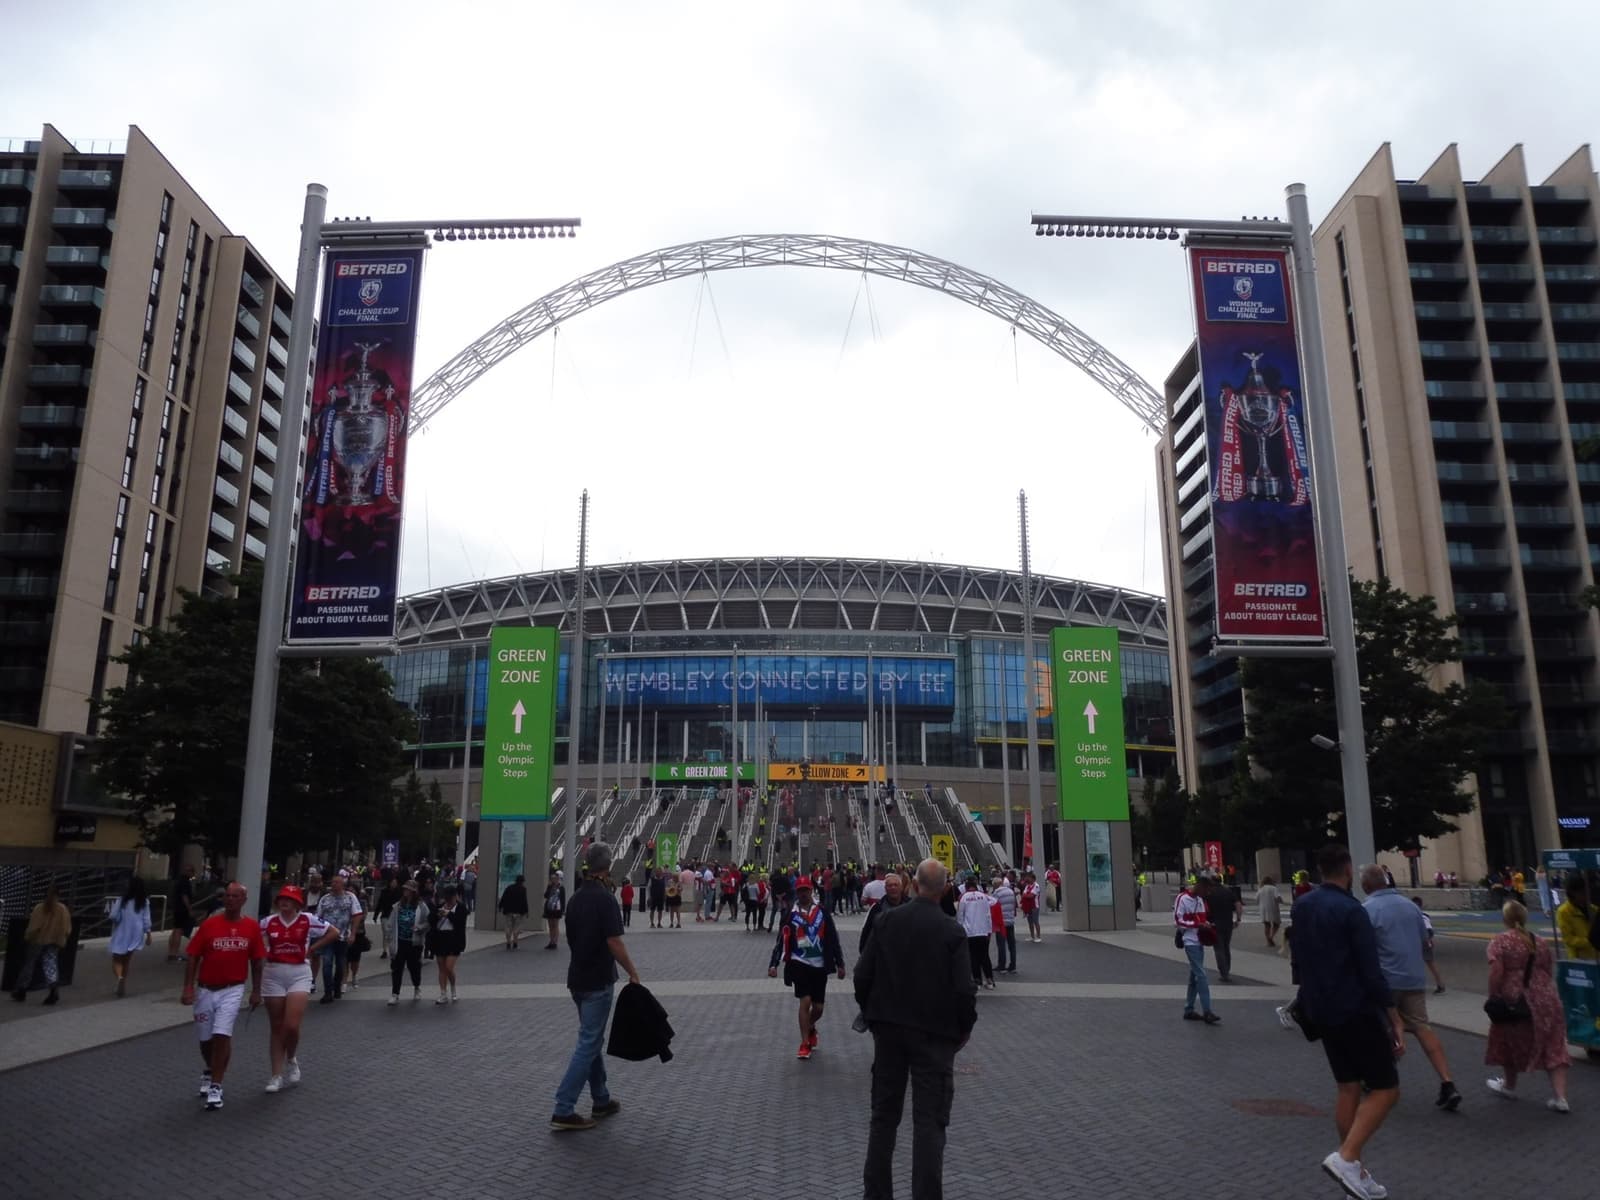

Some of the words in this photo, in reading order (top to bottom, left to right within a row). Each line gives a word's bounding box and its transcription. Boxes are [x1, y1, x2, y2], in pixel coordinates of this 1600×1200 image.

[338, 263, 407, 276] BETFRED
[1207, 262, 1275, 274] BETFRED
[1229, 300, 1263, 308] WOMEN'S
[338, 308, 383, 317] CHALLENGE
[383, 307, 399, 315] CUP
[1218, 306, 1259, 314] CHALLENGE
[1260, 307, 1275, 315] CUP
[356, 314, 379, 322] FINAL
[316, 459, 329, 504] BETFRED
[308, 586, 380, 600] BETFRED
[1234, 584, 1307, 597] BETFRED
[317, 605, 368, 614] PASSIONATE
[1245, 602, 1297, 611] PASSIONATE
[296, 615, 324, 624] ABOUT
[326, 615, 354, 623] RUGBY
[357, 614, 389, 623] LEAGUE
[1224, 612, 1254, 620] ABOUT
[1255, 612, 1283, 621] RUGBY
[1286, 613, 1318, 621] LEAGUE
[497, 649, 546, 662] GREEN
[1063, 649, 1111, 662] GREEN
[501, 670, 541, 683] ZONE
[605, 671, 714, 692] WEMBLEY
[722, 670, 867, 690] CONNECTED
[879, 671, 908, 691] BY
[919, 672, 946, 692] EE
[1068, 670, 1109, 683] ZONE
[502, 743, 515, 753] Up
[516, 742, 532, 751] the
[1077, 743, 1091, 753] Up
[1092, 742, 1108, 751] the
[498, 755, 534, 765] Olympic
[1075, 755, 1111, 766] Olympic
[503, 769, 528, 779] Steps
[685, 766, 708, 777] GREEN
[709, 766, 728, 777] ZONE
[804, 767, 831, 778] ELLOW
[832, 767, 849, 778] ZONE
[1081, 769, 1106, 779] Steps
